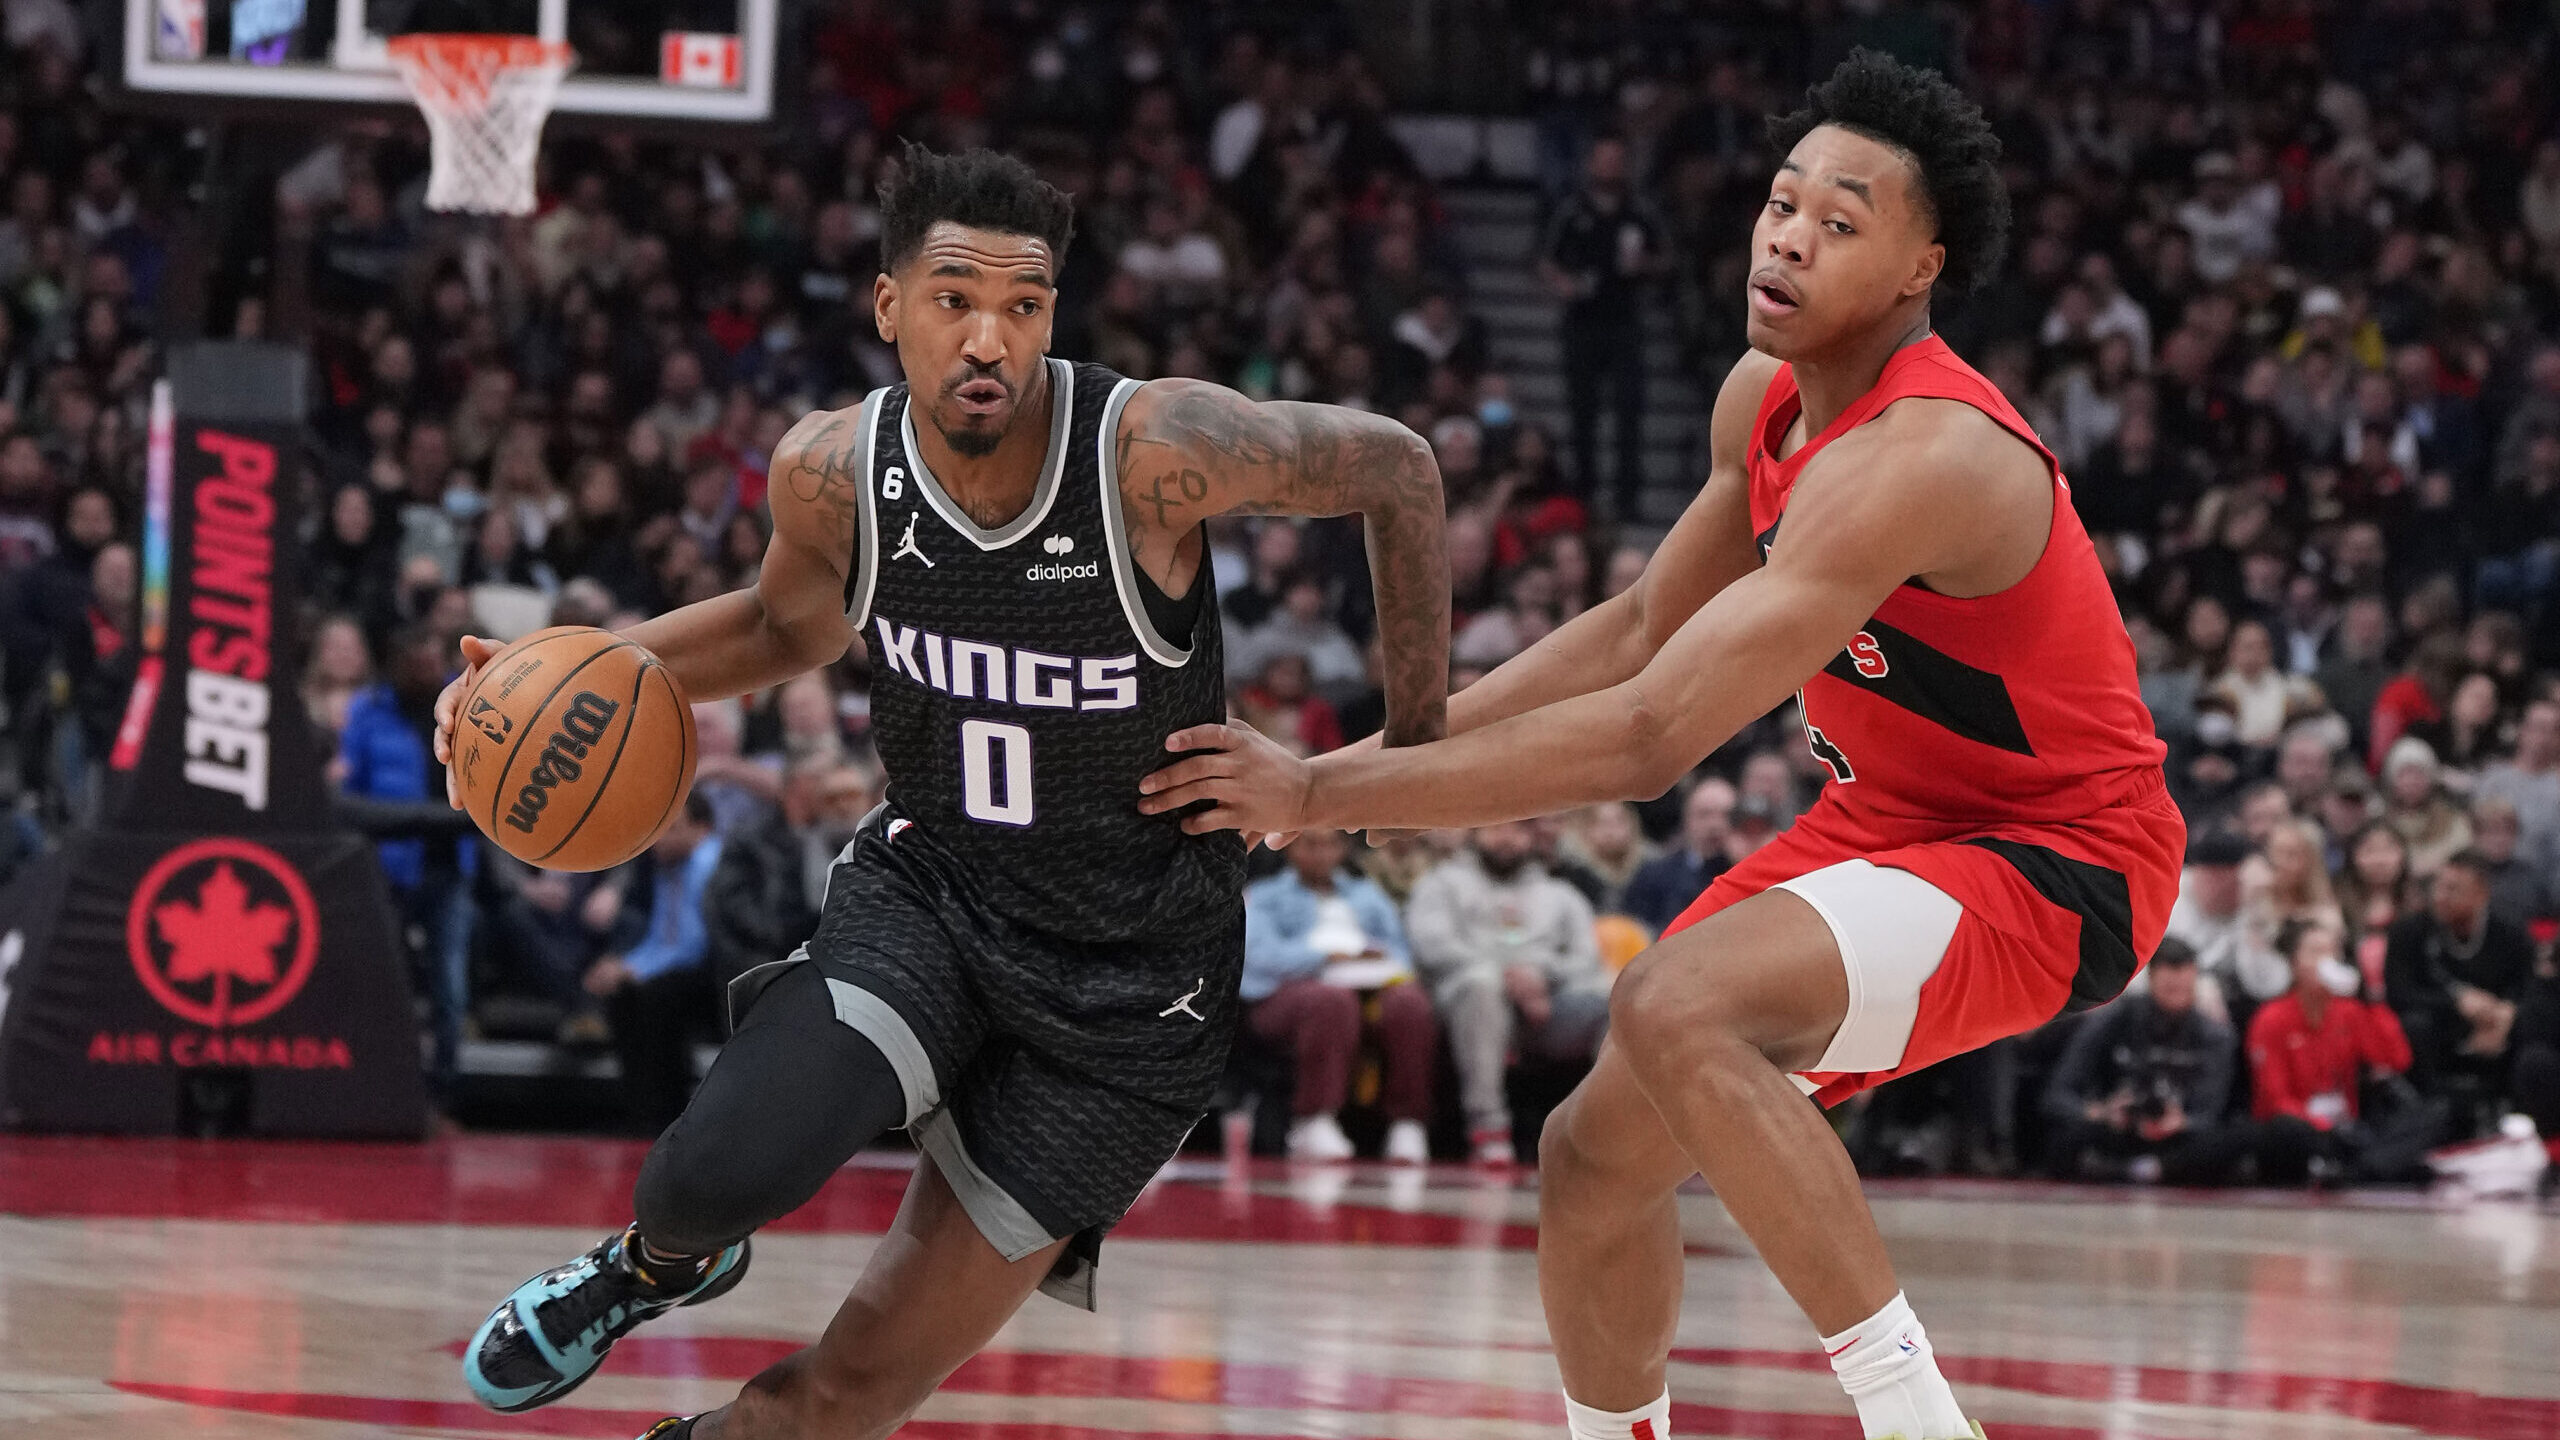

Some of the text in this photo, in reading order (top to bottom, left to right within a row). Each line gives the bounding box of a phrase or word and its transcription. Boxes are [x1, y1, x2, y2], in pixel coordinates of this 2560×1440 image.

[882, 466, 905, 501] 6
[184, 428, 278, 812] POINTSBET
[1026, 560, 1099, 583] dialpad
[874, 614, 1139, 712] KINGS
[505, 690, 620, 834] Wilson
[959, 718, 1036, 828] 0
[89, 1033, 353, 1069] AIR CANADA
